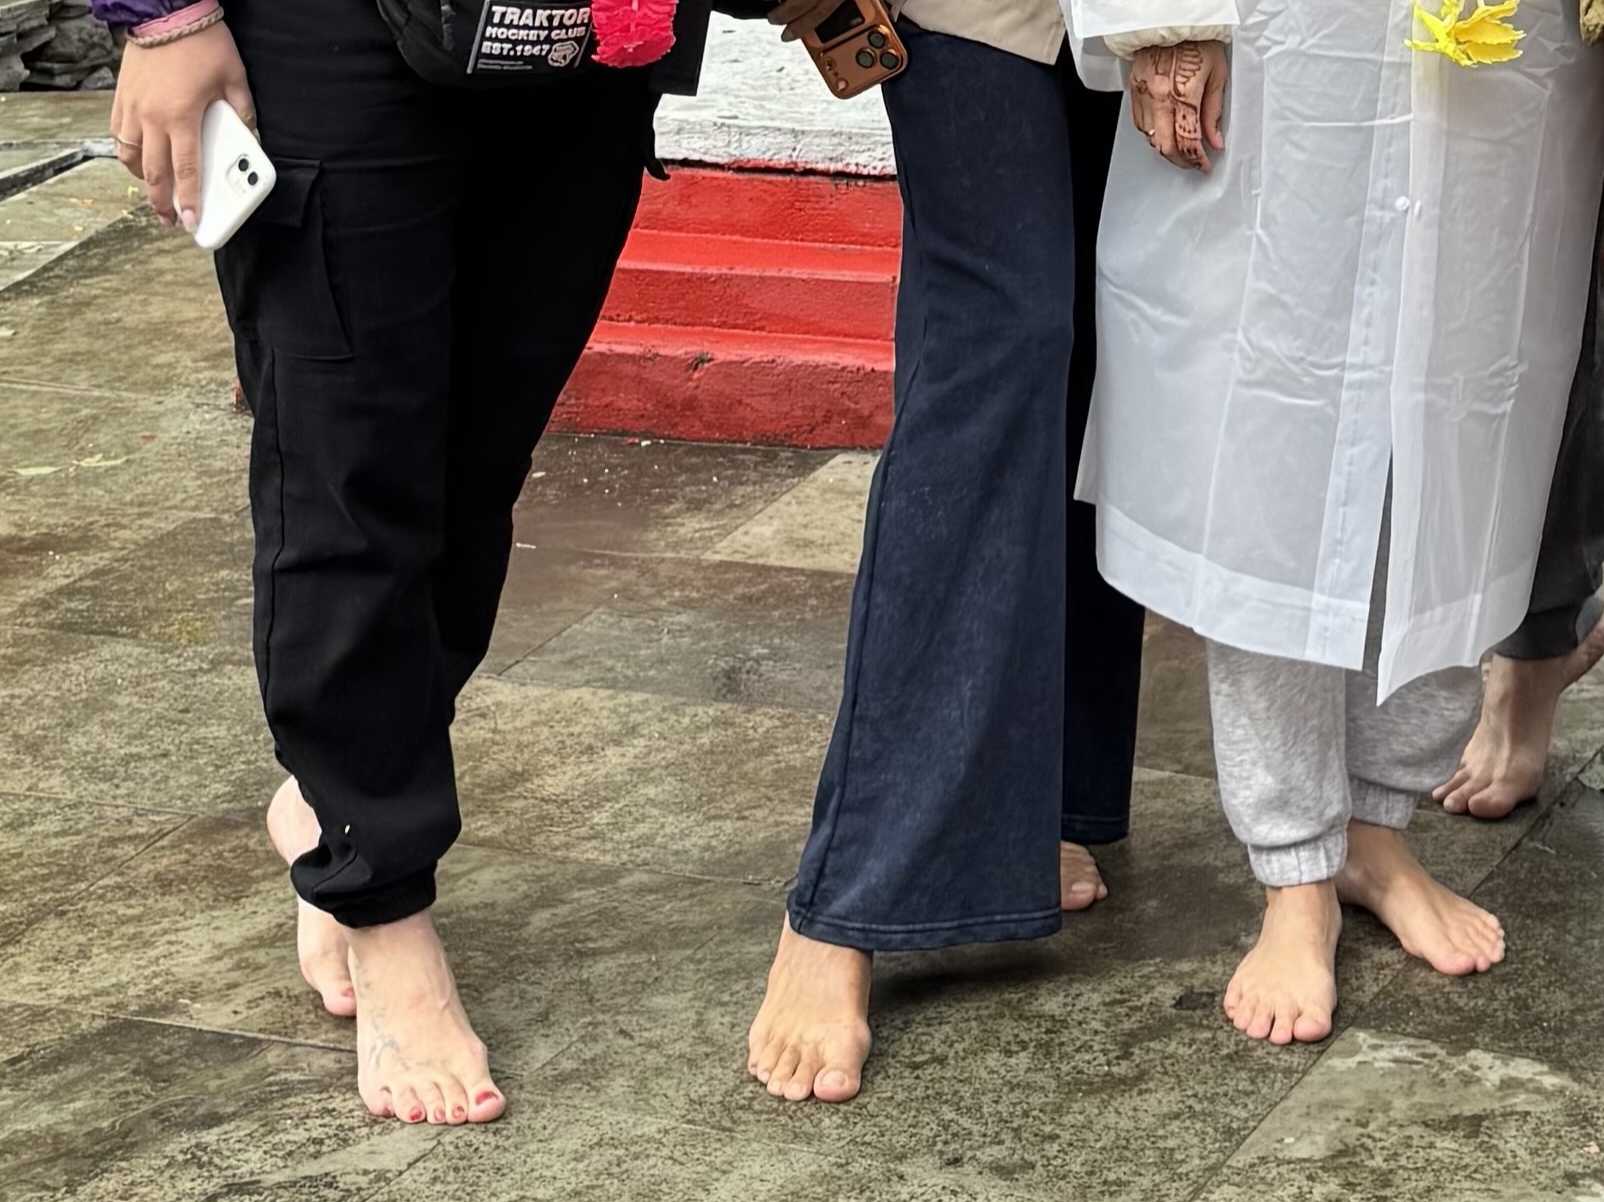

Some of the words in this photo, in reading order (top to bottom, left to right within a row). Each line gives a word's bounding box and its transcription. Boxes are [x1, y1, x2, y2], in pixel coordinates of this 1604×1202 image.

[491, 5, 591, 27] TRAKTOR
[485, 25, 549, 41] HOCKEY
[550, 26, 587, 39] CLUB
